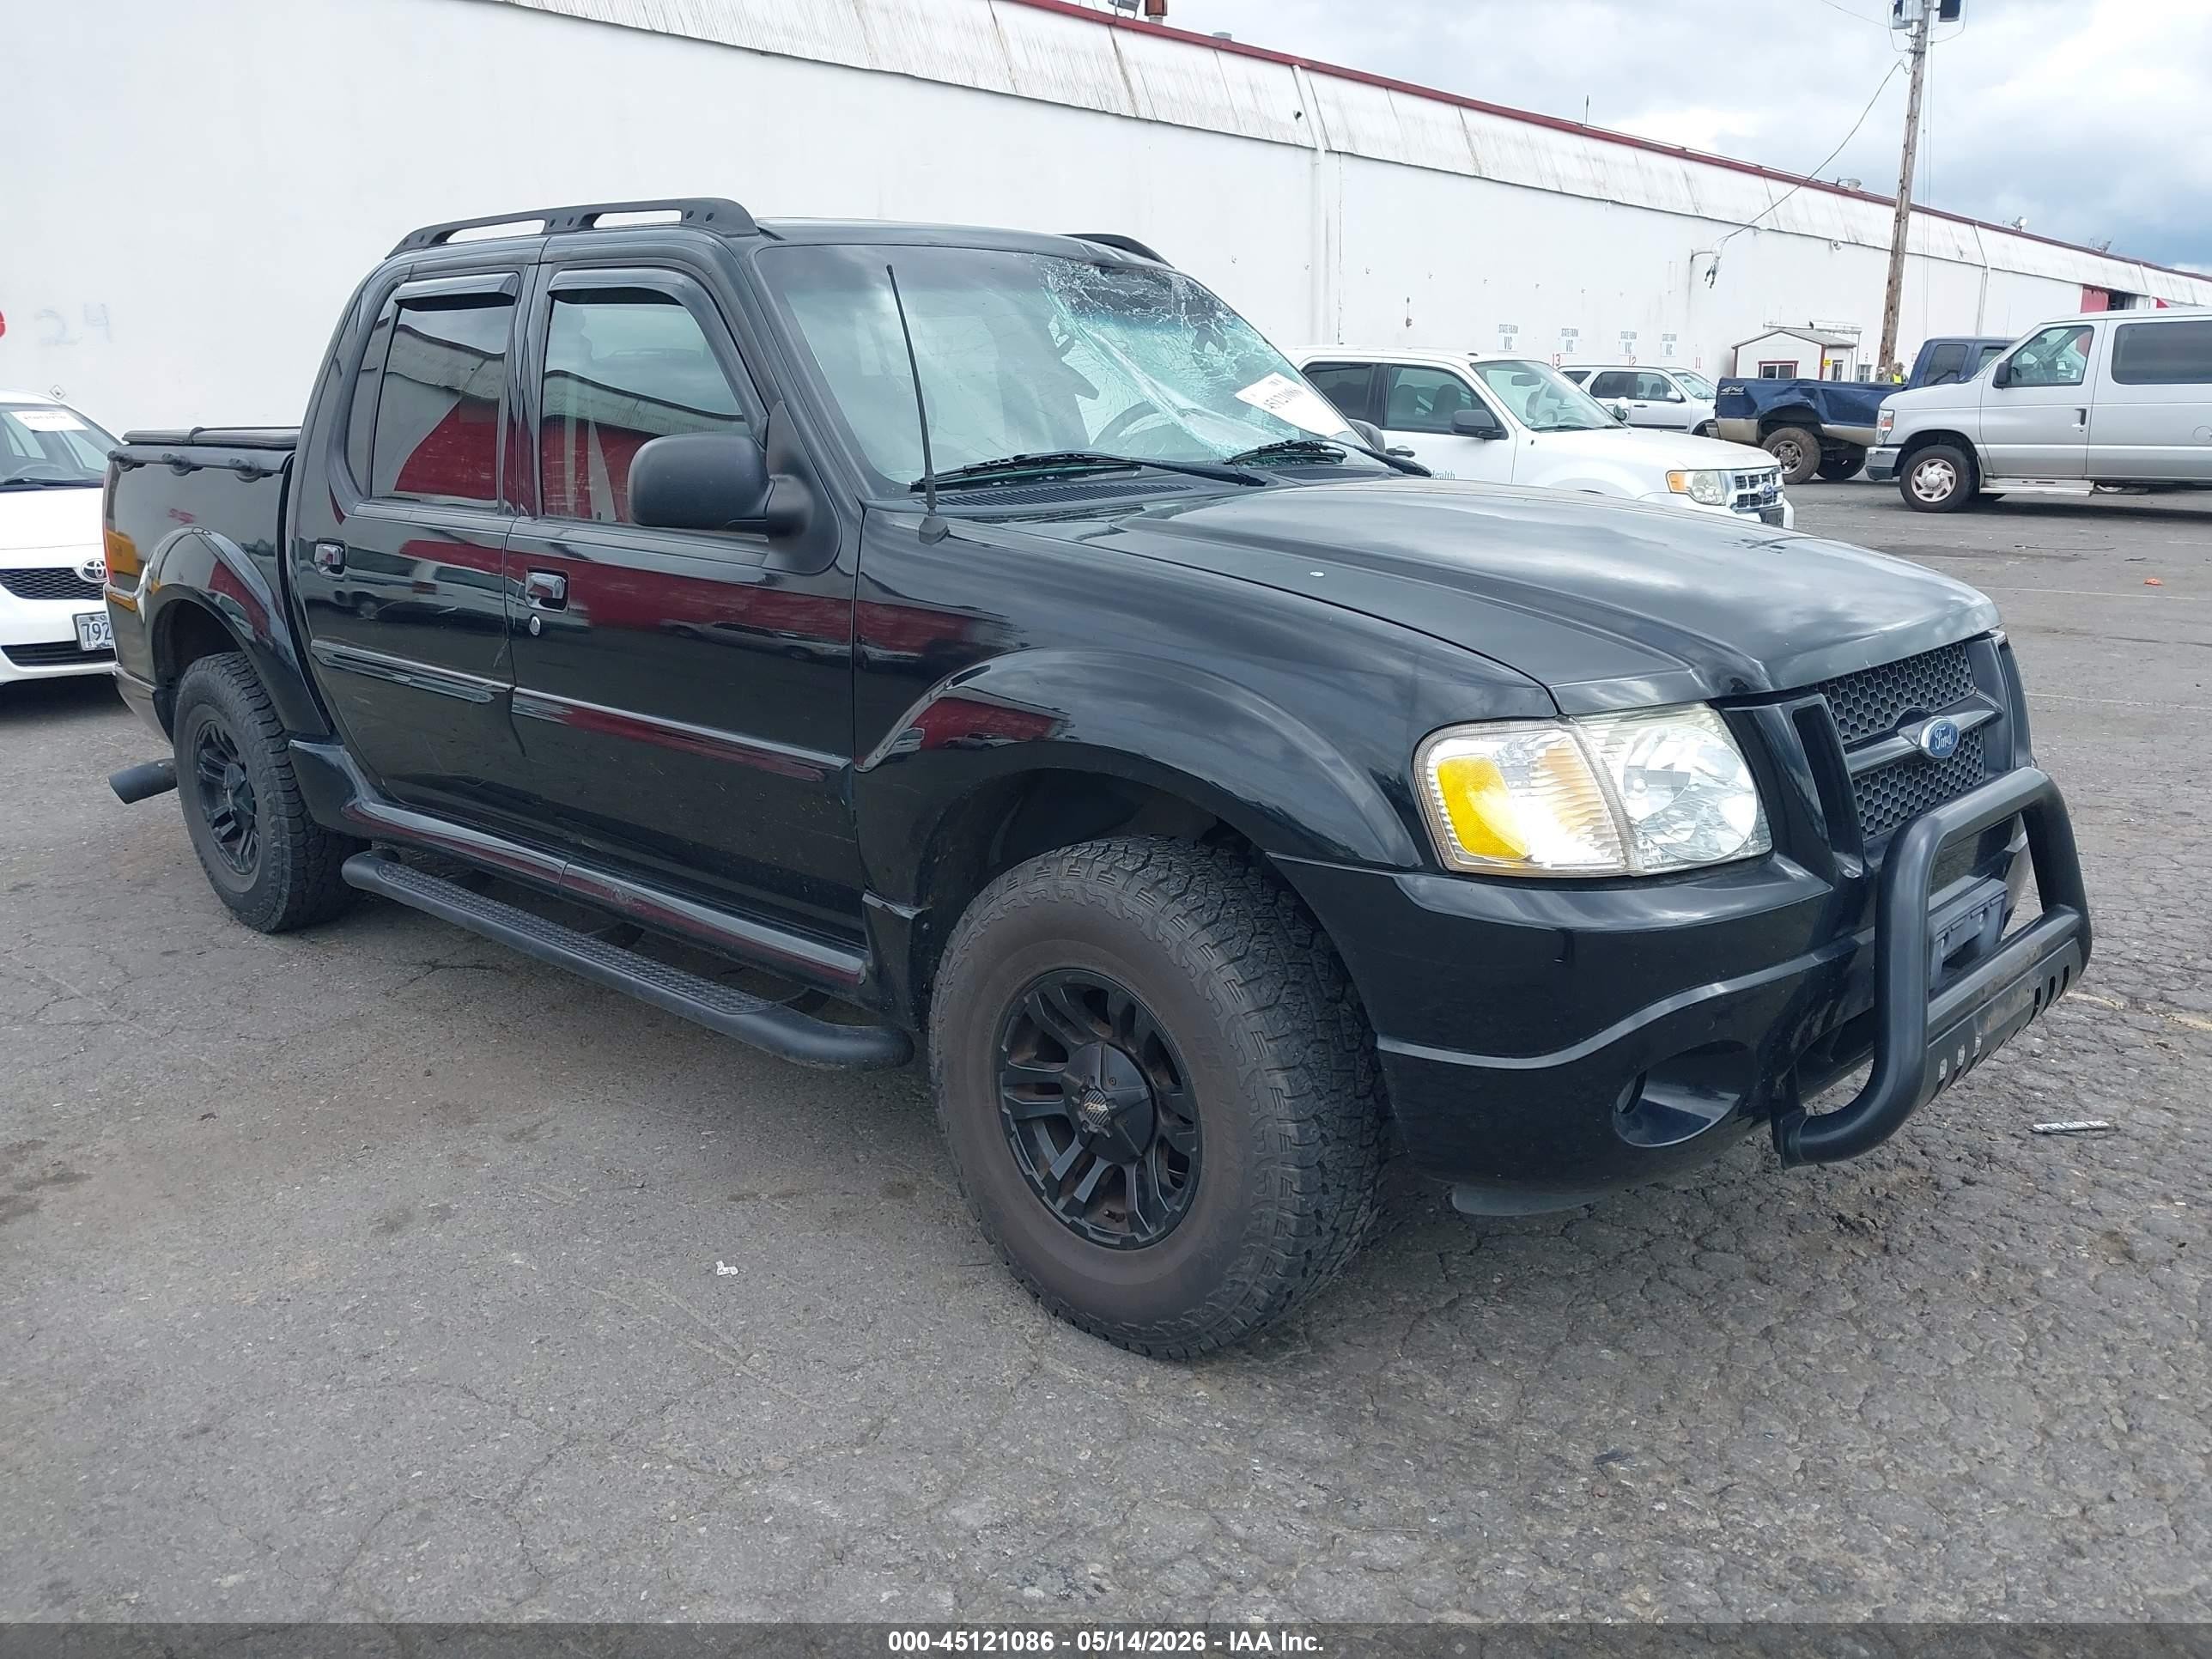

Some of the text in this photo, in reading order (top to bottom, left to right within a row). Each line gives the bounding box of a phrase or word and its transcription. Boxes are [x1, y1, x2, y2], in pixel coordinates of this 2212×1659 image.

[1552, 353, 1561, 367] 13
[1628, 355, 1637, 367] 12
[81, 622, 112, 641] 792
[1935, 726, 1954, 750] Ford
